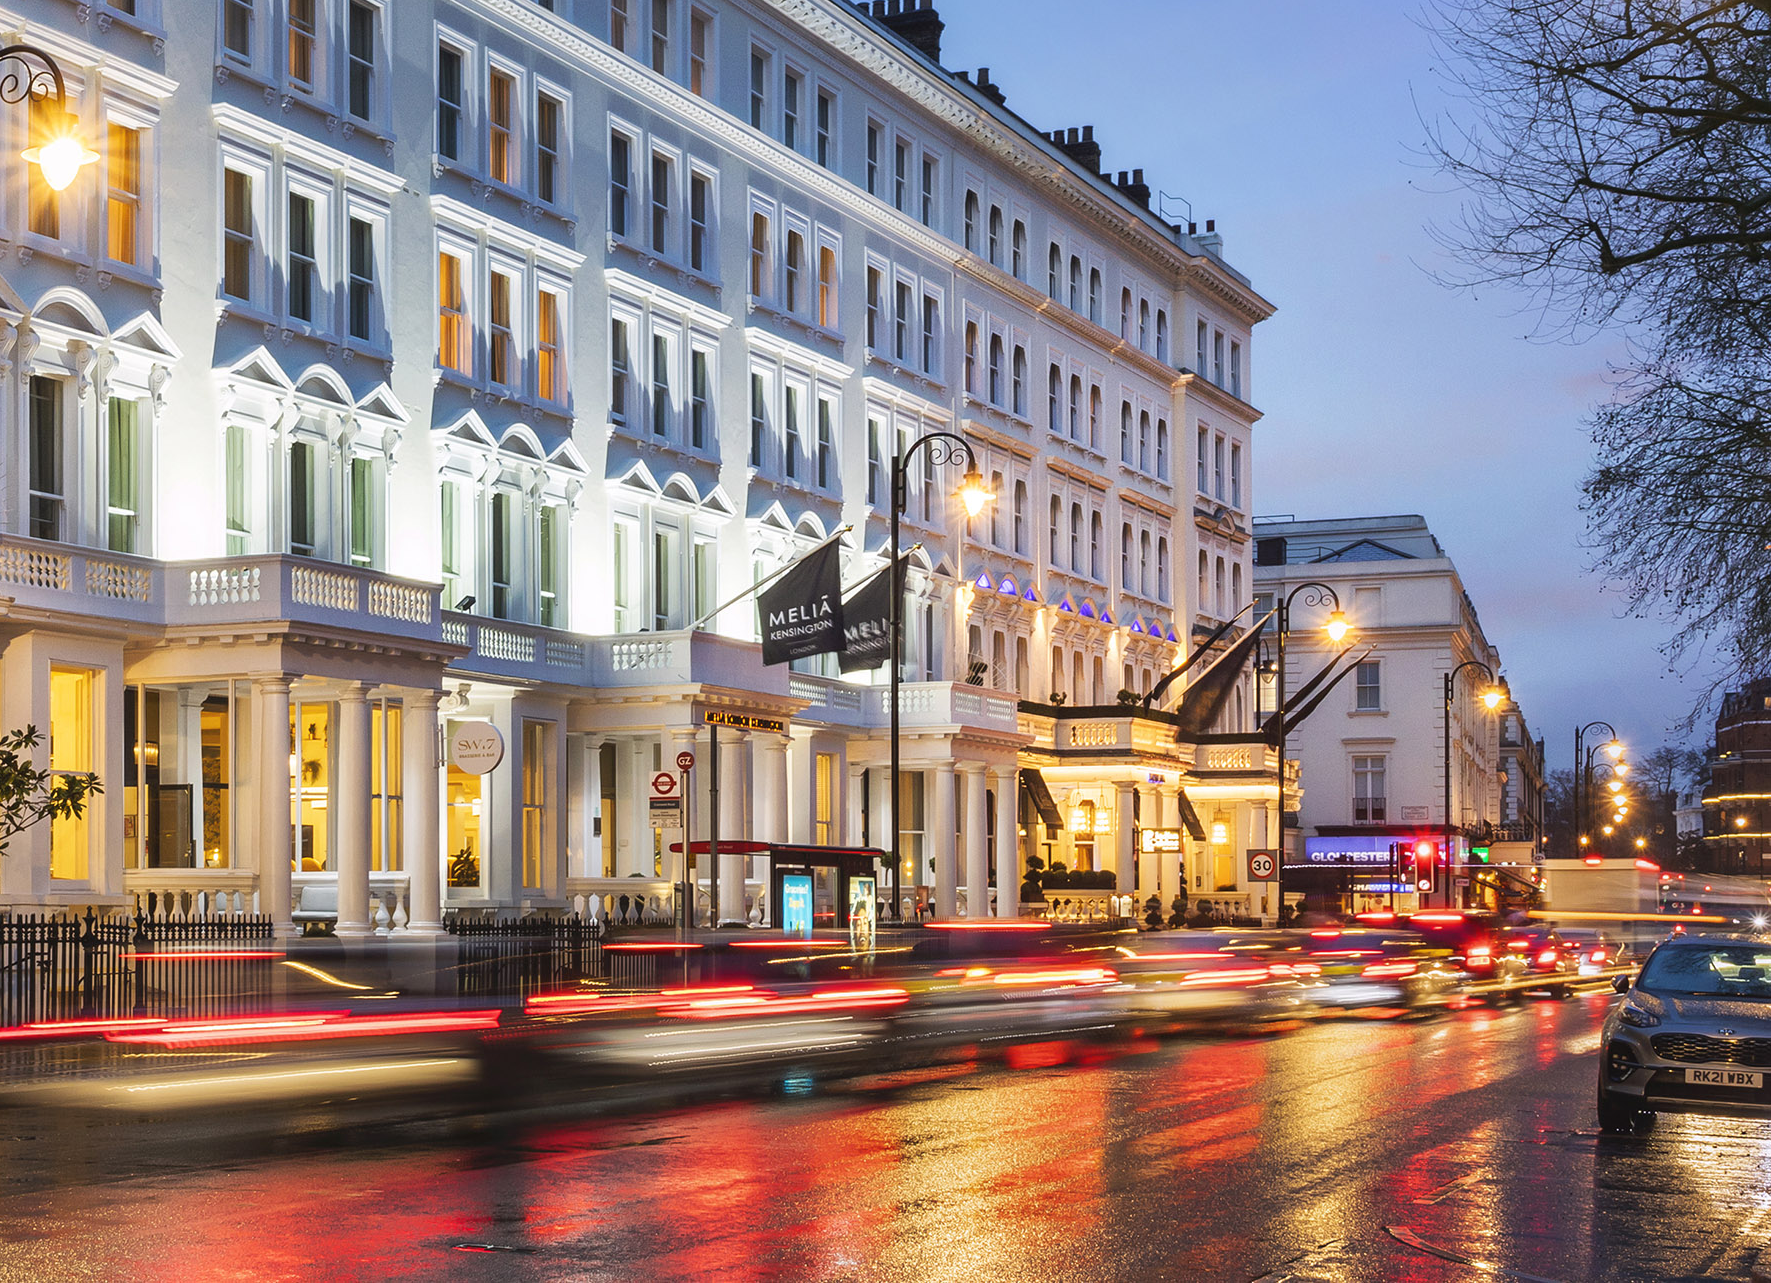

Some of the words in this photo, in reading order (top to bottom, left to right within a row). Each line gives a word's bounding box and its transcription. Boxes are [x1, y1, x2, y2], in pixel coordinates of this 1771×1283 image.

[770, 619, 833, 641] KENSINGTON
[790, 644, 817, 655] LONDON
[678, 756, 691, 765] GZ
[1253, 860, 1271, 871] 30
[1693, 1070, 1723, 1083] RK21
[1728, 1073, 1754, 1085] WBX
